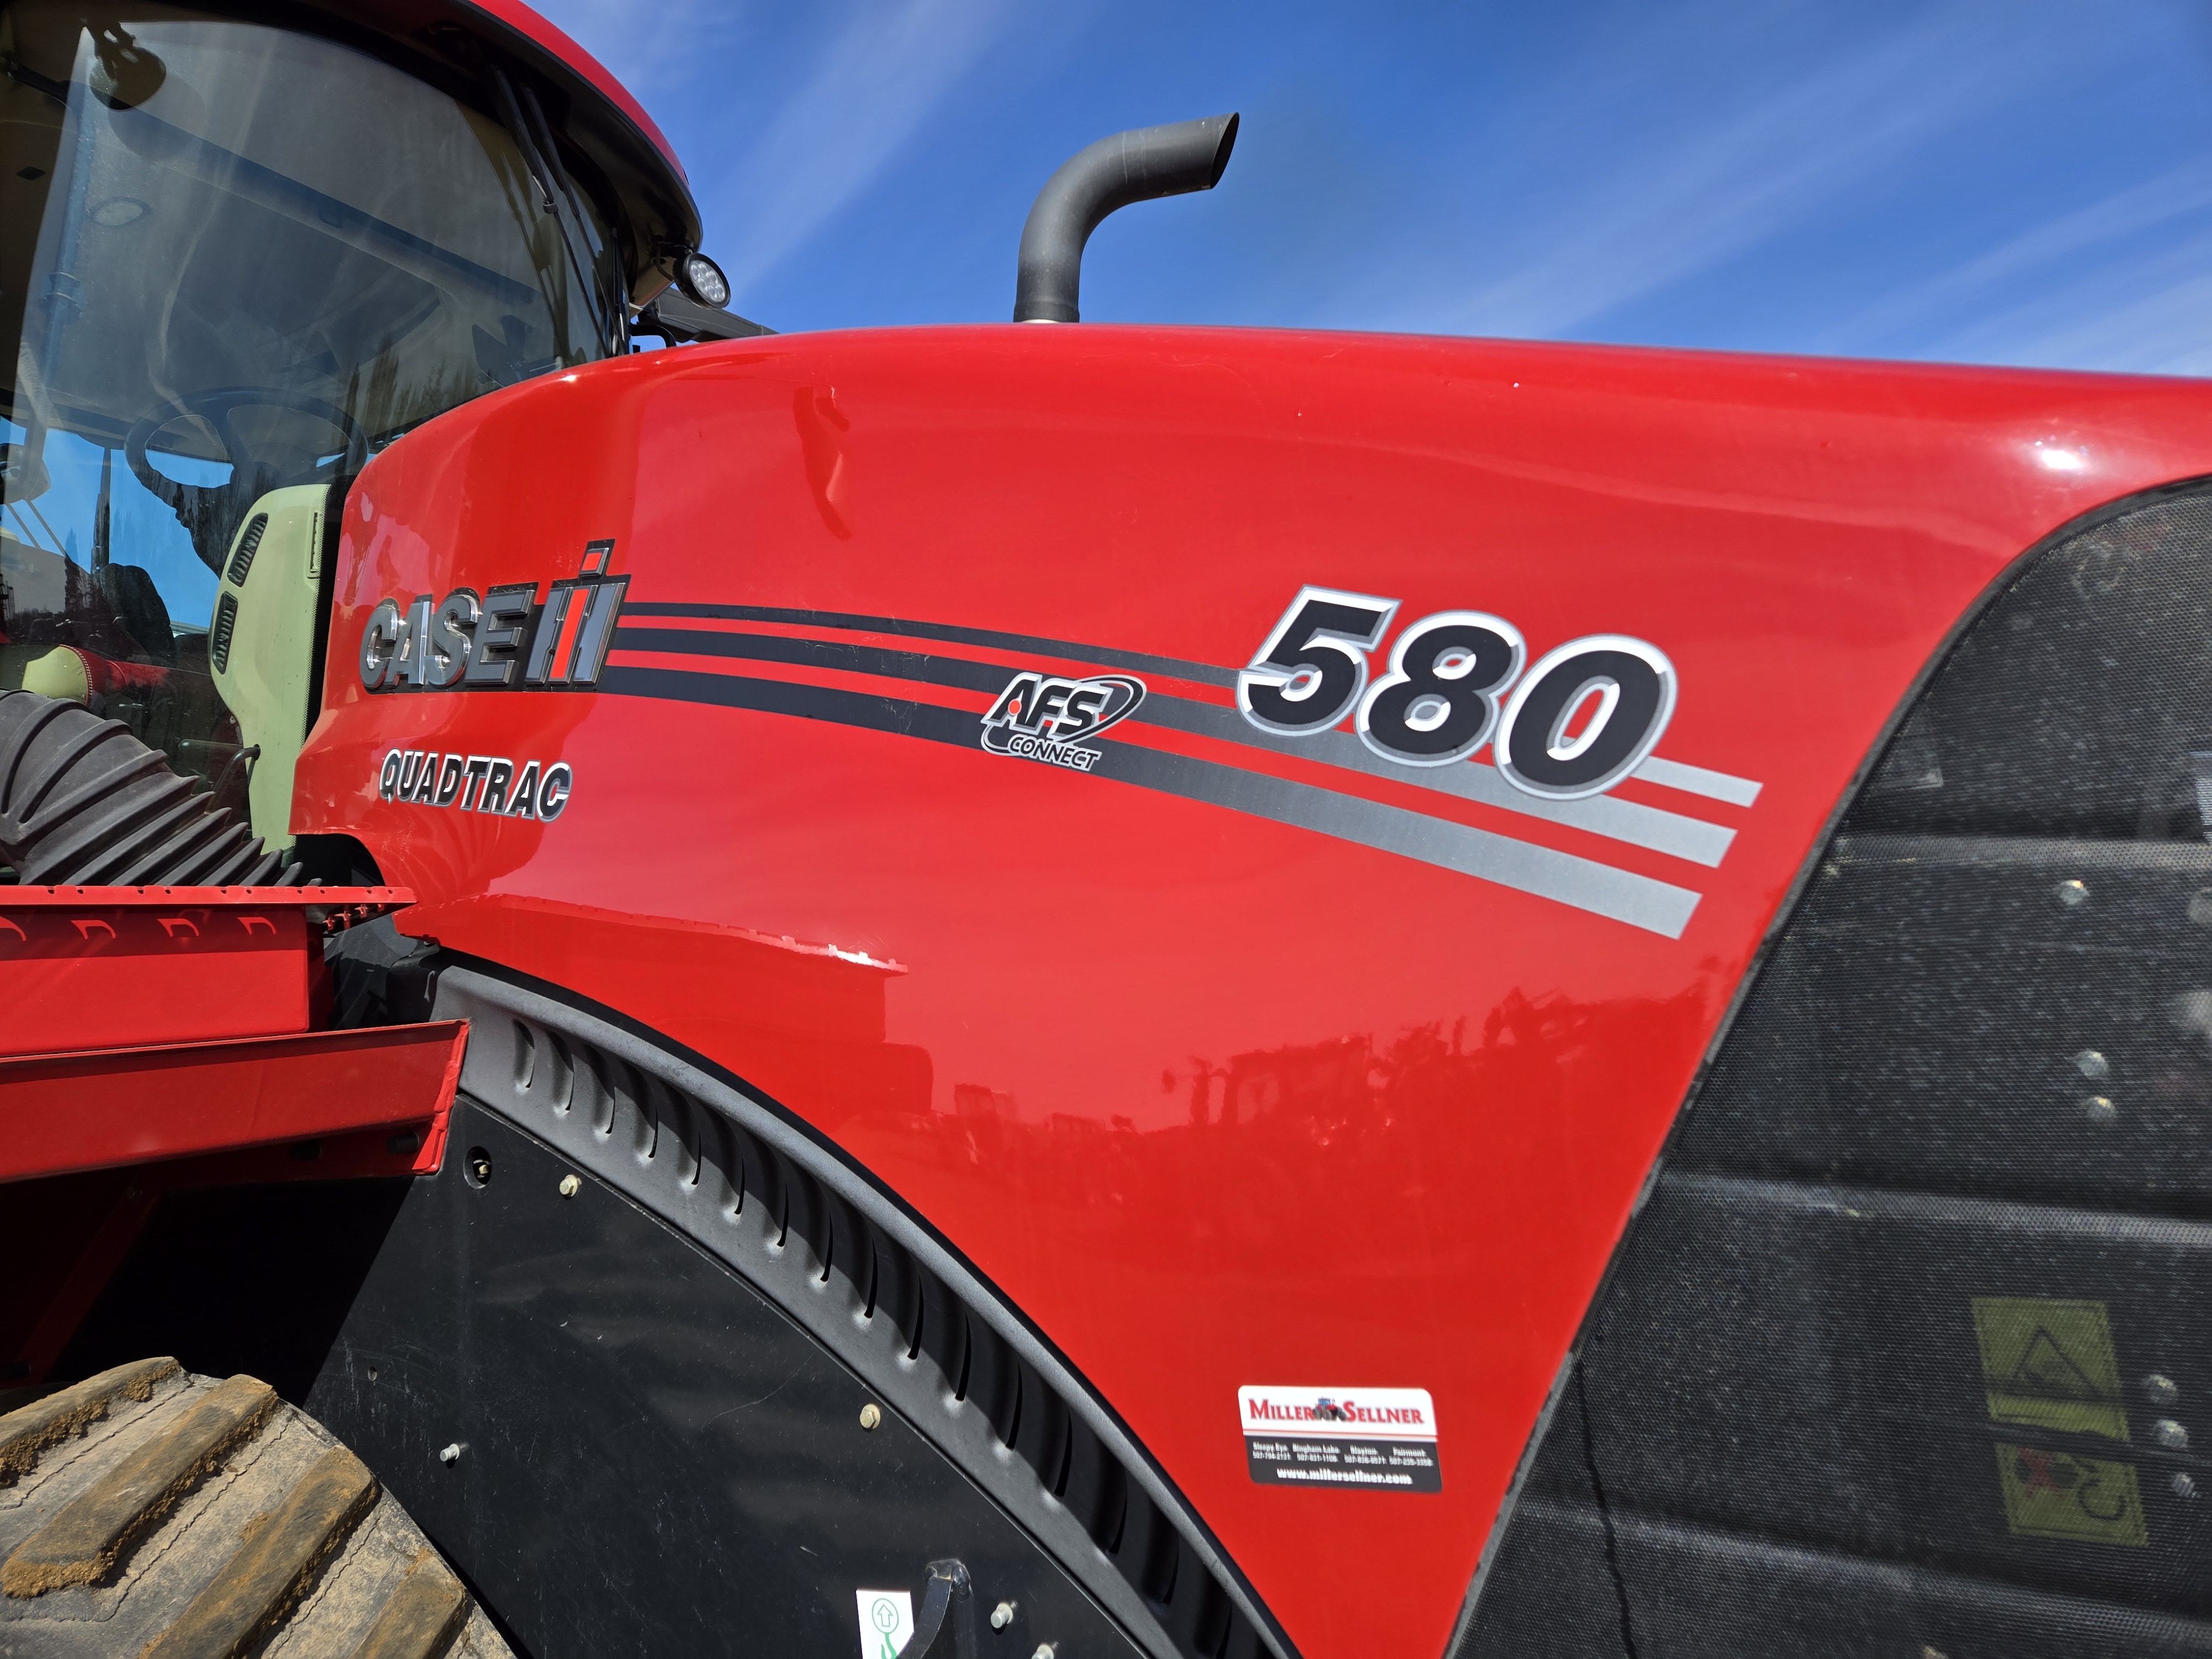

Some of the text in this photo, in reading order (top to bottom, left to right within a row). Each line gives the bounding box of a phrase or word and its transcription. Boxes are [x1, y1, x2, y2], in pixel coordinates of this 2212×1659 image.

[1236, 584, 1678, 801] 580
[980, 672, 1113, 738] AFS
[1008, 734, 1102, 771] CONNECT
[379, 748, 573, 823] QUADTRAC
[1253, 1441, 1288, 1453] Sleepy Eye
[1292, 1442, 1340, 1454] Bingham Lake
[1350, 1444, 1379, 1457] Slayton
[1392, 1446, 1427, 1457] Fairmont
[1276, 1468, 1412, 1485] www.millersellner.com
